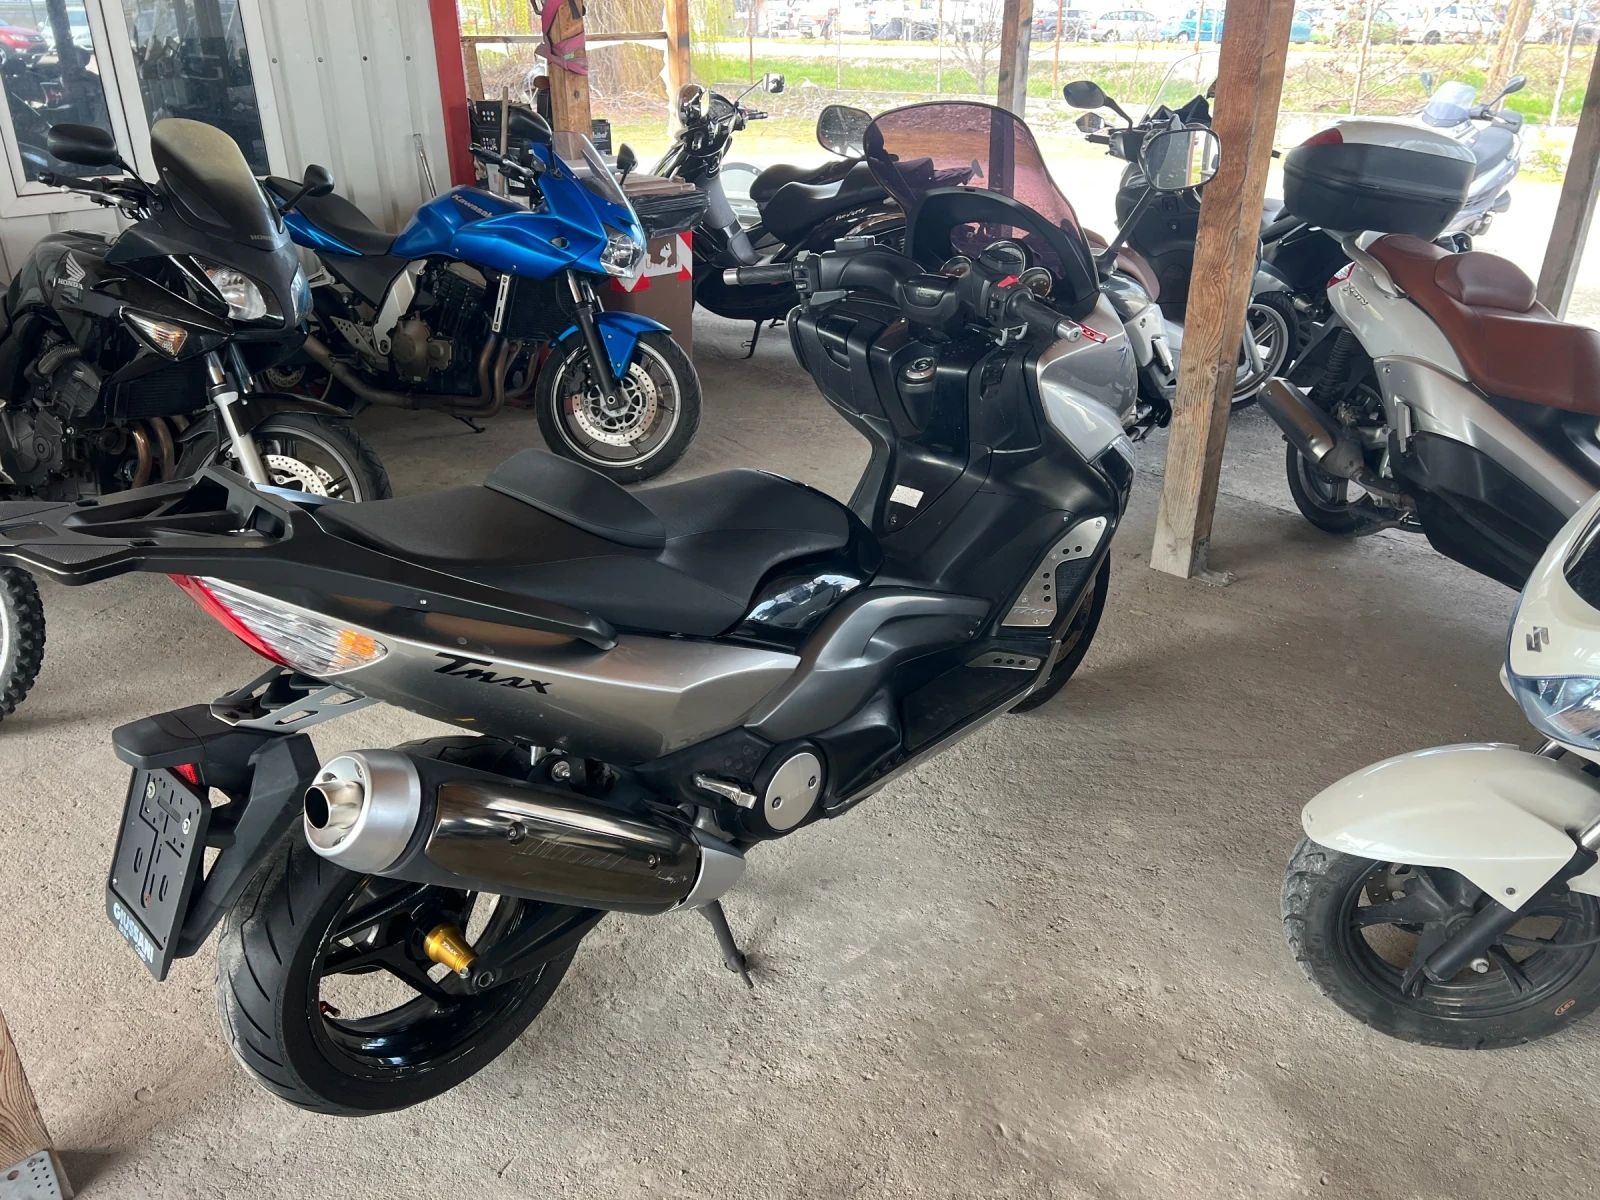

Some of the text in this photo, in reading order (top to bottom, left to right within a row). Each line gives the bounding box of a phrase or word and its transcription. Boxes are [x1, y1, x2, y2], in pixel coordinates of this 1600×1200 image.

[452, 193, 493, 218] Kawasak
[57, 277, 84, 290] HONDA
[113, 902, 154, 964] GIUSSANI
